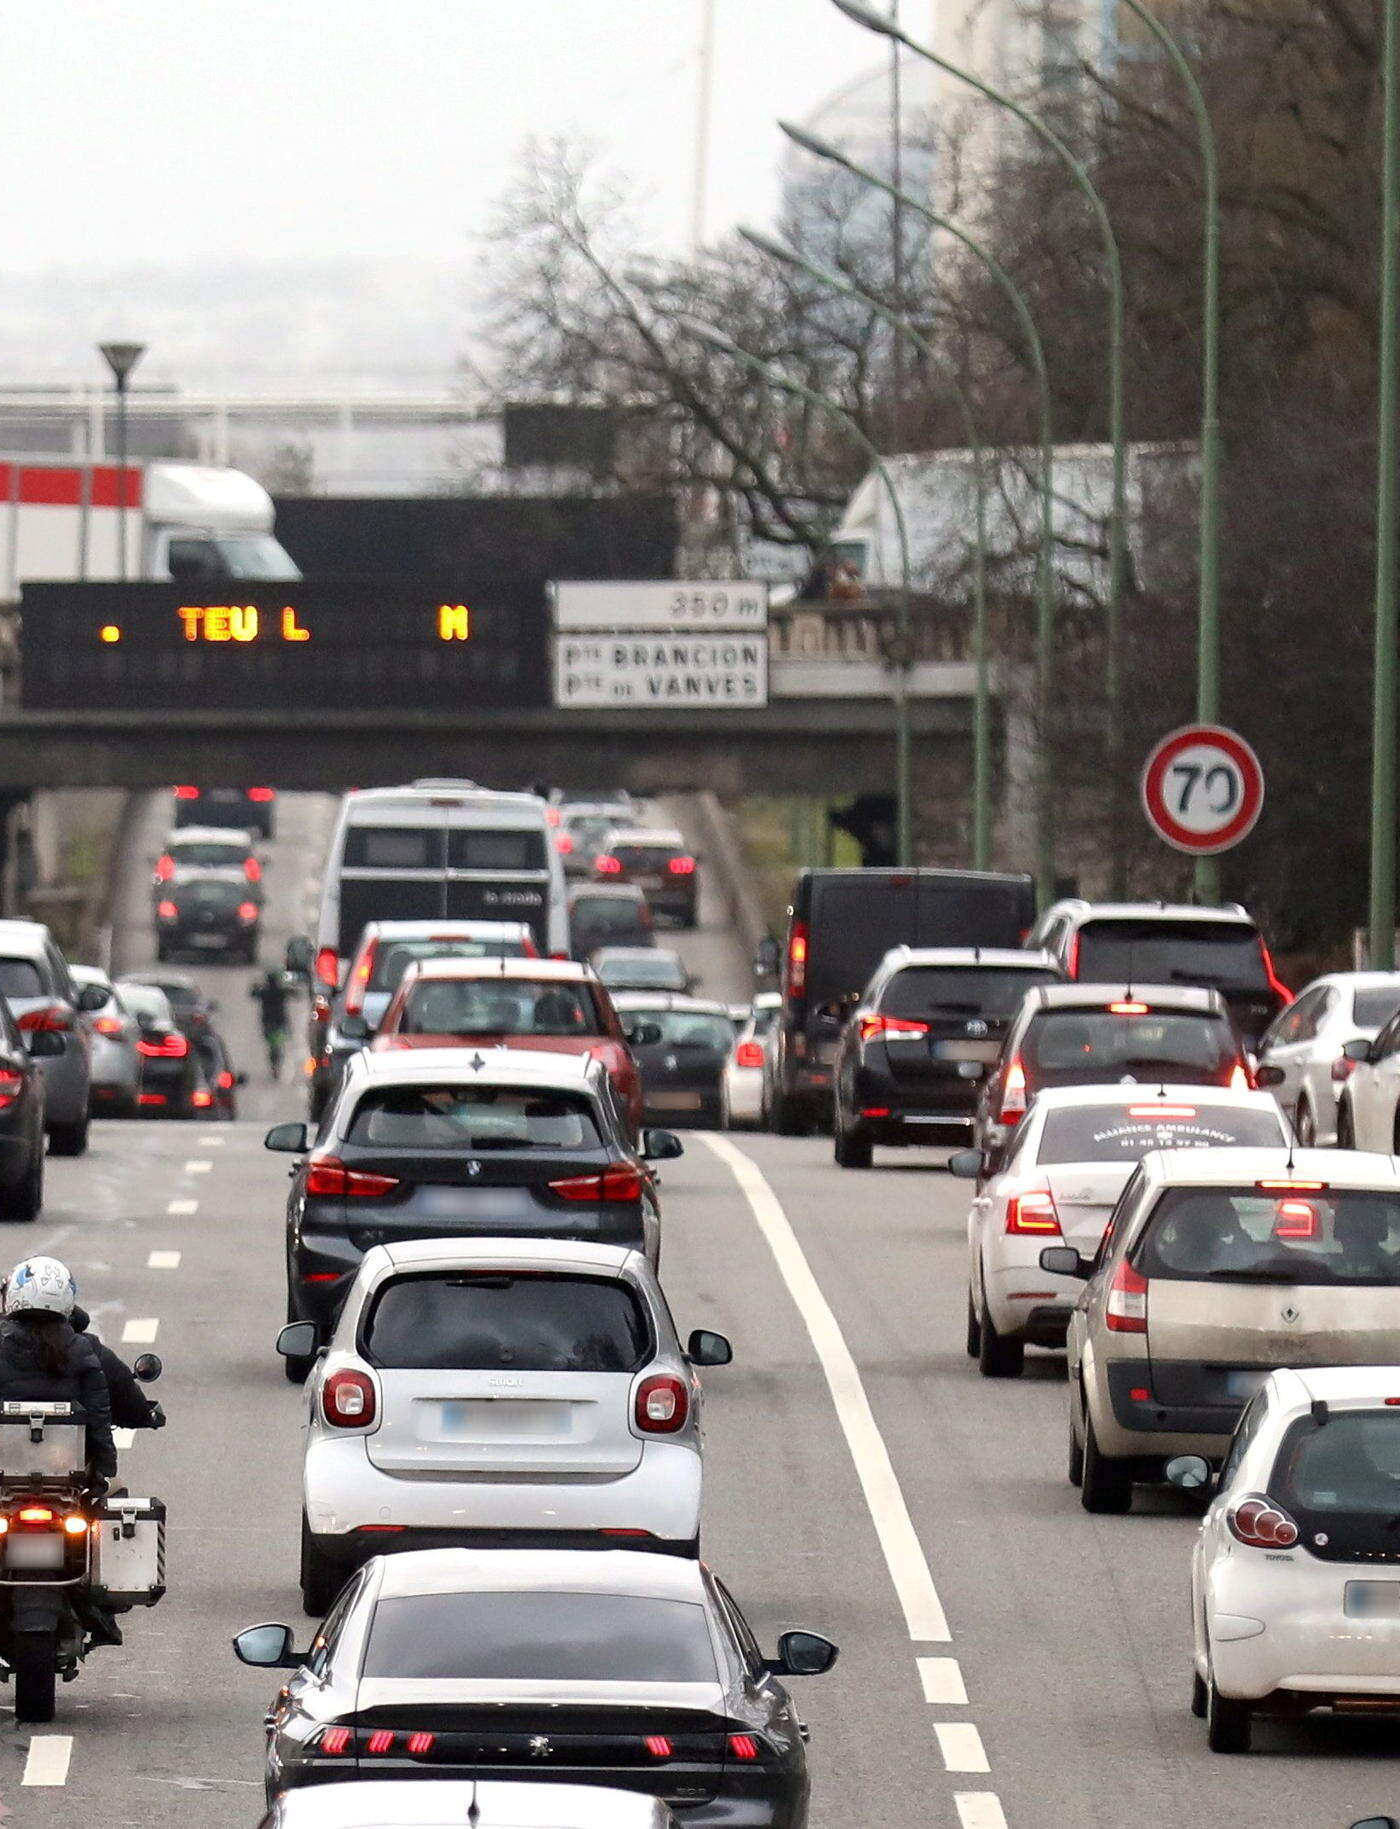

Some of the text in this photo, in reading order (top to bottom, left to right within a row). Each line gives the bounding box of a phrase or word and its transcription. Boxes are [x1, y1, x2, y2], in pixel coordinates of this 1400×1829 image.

[671, 591, 728, 617] 350
[178, 605, 469, 642] TEU L M
[614, 644, 758, 668] BRANCION
[647, 674, 758, 698] VANVES
[1172, 764, 1240, 814] 70
